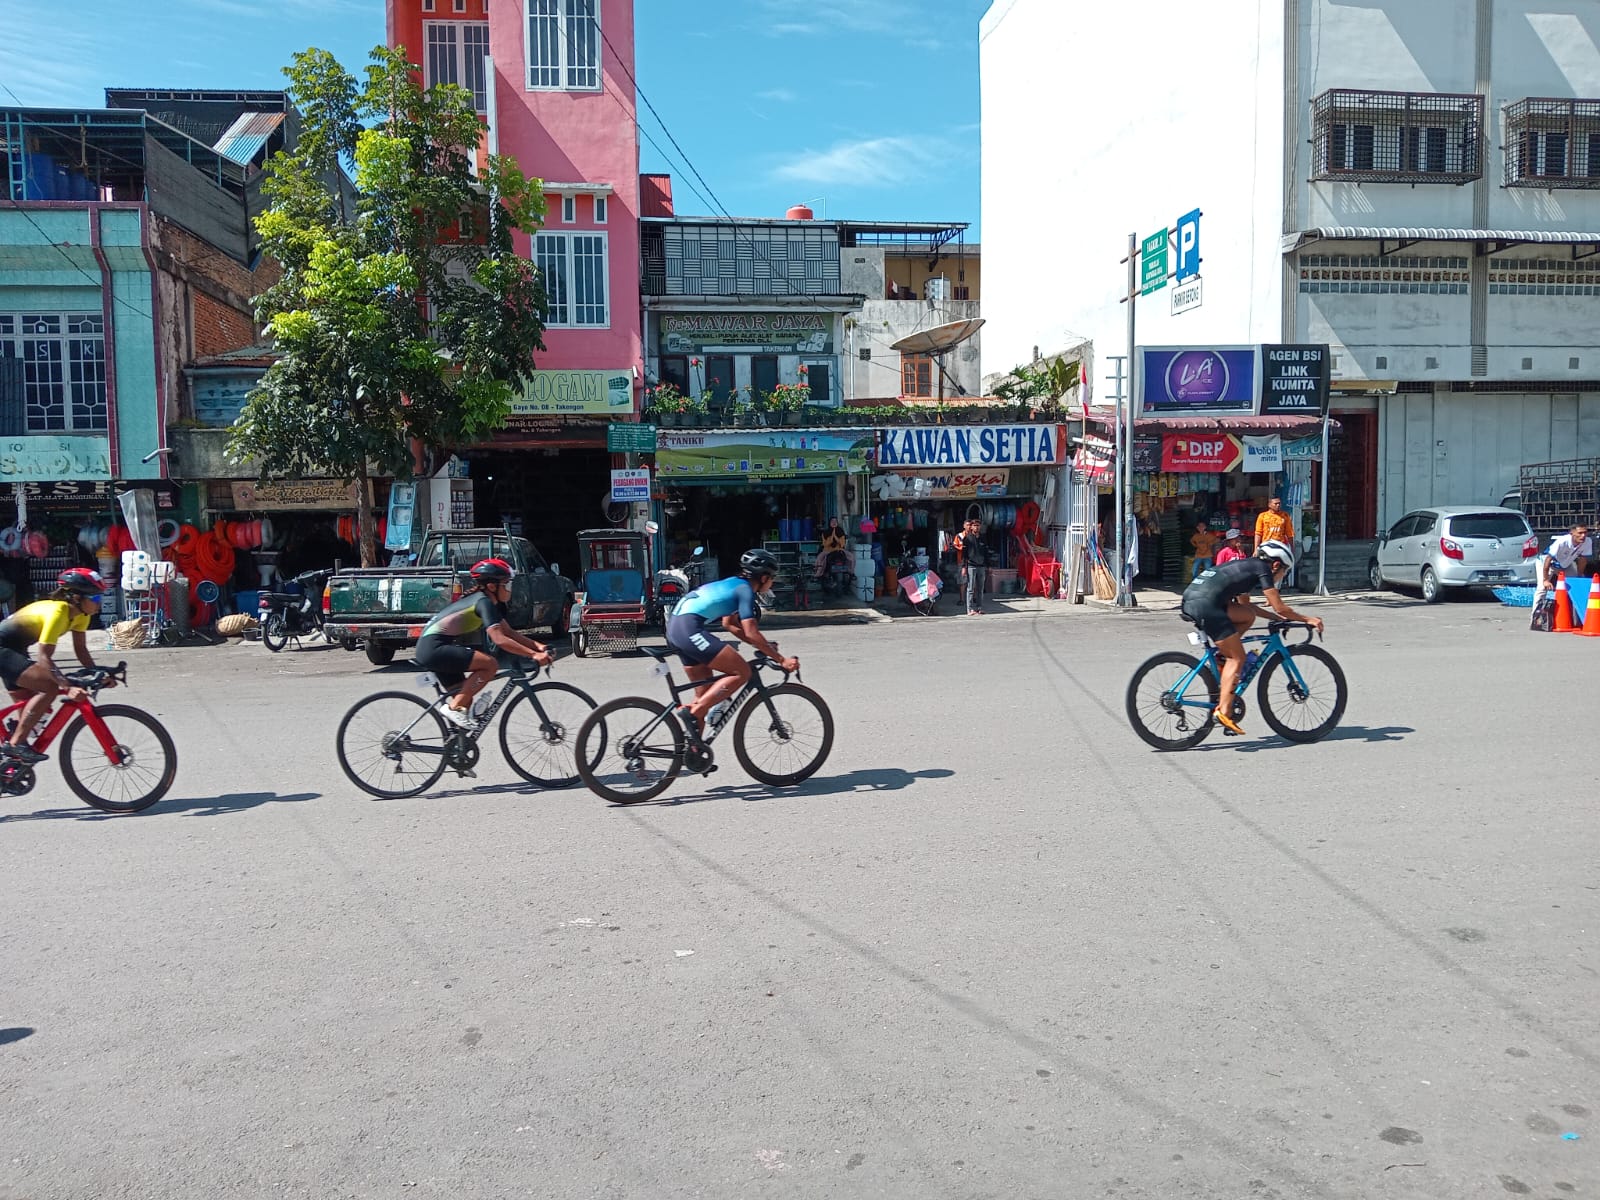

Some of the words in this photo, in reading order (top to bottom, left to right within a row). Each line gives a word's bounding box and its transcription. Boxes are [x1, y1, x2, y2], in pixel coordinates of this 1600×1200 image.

[1180, 220, 1196, 270] P
[684, 315, 767, 331] MAWAR
[770, 314, 825, 330] JAYA
[1269, 350, 1301, 361] AGEN
[1303, 350, 1322, 361] BSI
[1281, 365, 1309, 377] LINK
[522, 373, 604, 401] LOGAM
[1271, 379, 1316, 391] KUMITA
[1278, 394, 1308, 406] JAYA
[880, 428, 971, 465] KAWAN
[979, 427, 1054, 463] SETIA
[1189, 440, 1225, 457] DRP
